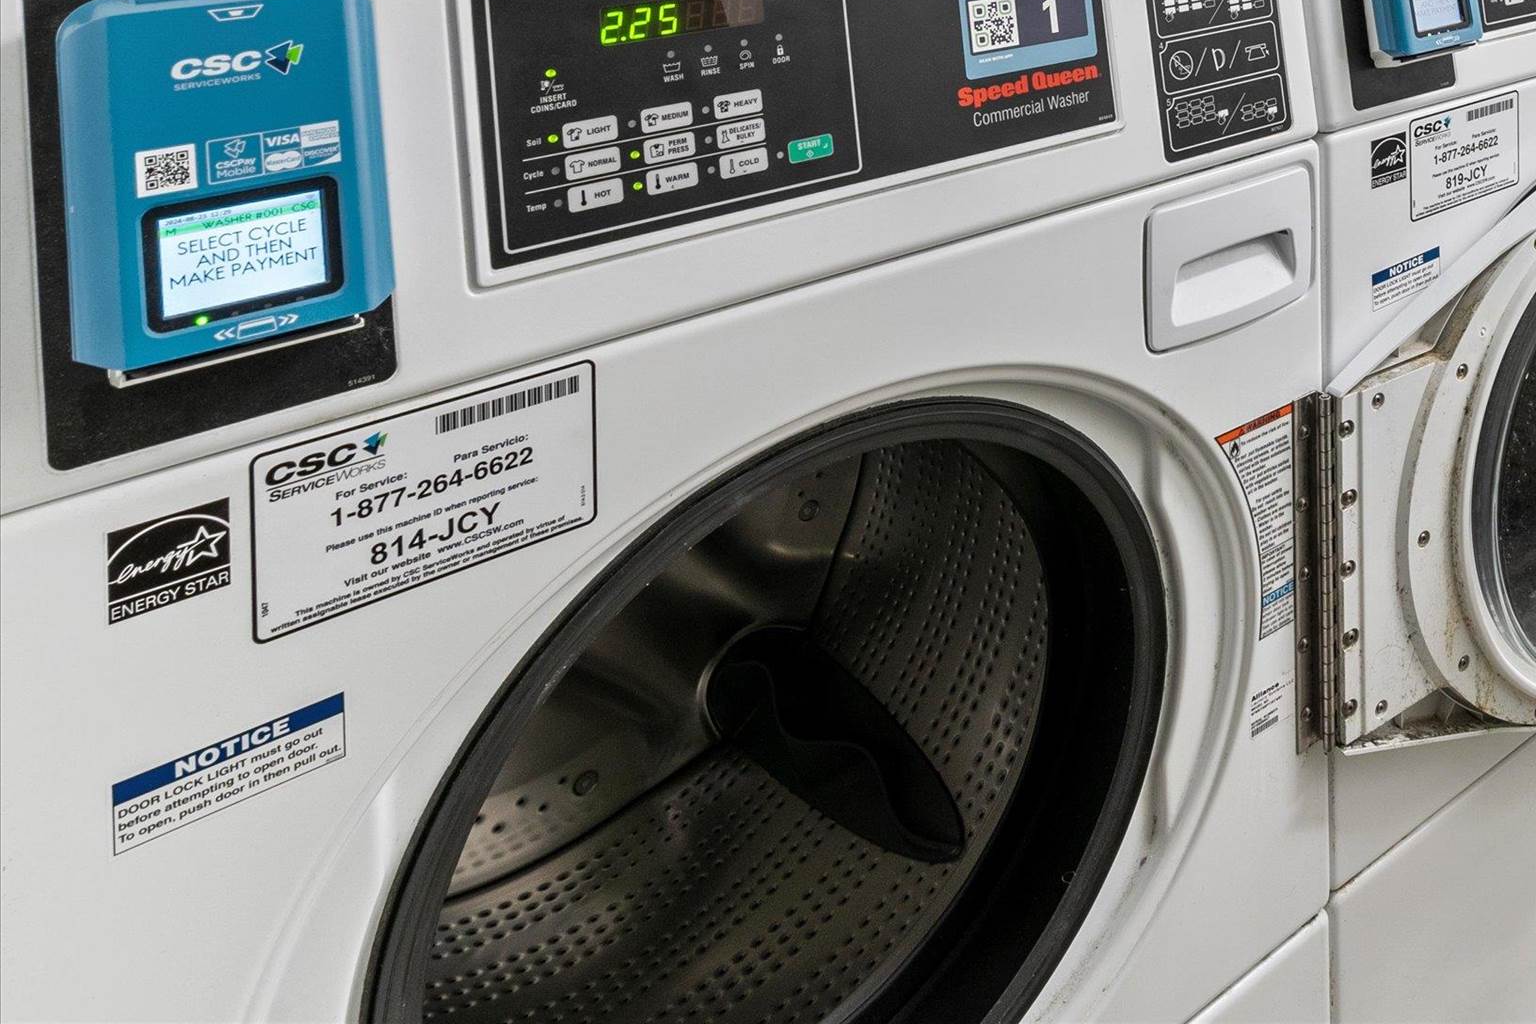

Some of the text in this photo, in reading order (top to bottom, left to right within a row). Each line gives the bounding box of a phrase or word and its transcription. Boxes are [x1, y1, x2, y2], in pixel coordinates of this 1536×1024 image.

[598, 2, 679, 45] 2.25
[170, 50, 262, 80] CSC
[700, 66, 720, 77] RINSE
[739, 60, 754, 70] SPIN
[772, 54, 790, 65] DOOR
[173, 73, 261, 91] SERVICEWORKS
[663, 72, 684, 83] WASH
[957, 64, 1098, 108] Speed Queen
[661, 109, 689, 122] MEDIUM
[733, 97, 757, 108] HEAVY
[973, 90, 1089, 127] Commercial Washer
[525, 136, 541, 147] Soil
[586, 124, 610, 136] LIGHT
[668, 137, 687, 147] PERM
[1413, 119, 1441, 138] CSC
[667, 144, 689, 155] PRESS
[797, 139, 821, 151] START
[1434, 134, 1498, 165] 1-877-264-6622
[522, 168, 544, 181] Cycle
[587, 155, 617, 168] NORMAL
[739, 156, 759, 167] COLD
[665, 171, 689, 183] WARM
[1445, 163, 1487, 190] 819-JCY
[594, 188, 611, 199] HOT
[165, 227, 176, 236] M
[201, 212, 252, 229] WASHER
[255, 206, 283, 219] #001
[291, 200, 315, 212] CSC
[526, 201, 546, 214] Temp
[177, 230, 242, 255] SELECT
[248, 217, 306, 241] CYCLE
[195, 236, 291, 268] AND THEN
[1389, 254, 1423, 277] NOTICE
[169, 246, 318, 290] MAKE PAYMENT
[453, 432, 528, 463] Para Servicio:
[264, 440, 357, 488] CSC
[330, 445, 533, 528] 1-877-264-6622
[335, 470, 407, 500] For Service:
[325, 476, 538, 553] Please use this machine ID when reporting service:
[370, 501, 501, 566] 814-JCY
[344, 517, 523, 587] Visit our website www.CSCSW.com
[111, 569, 228, 621] ENERGY STAR
[1262, 582, 1294, 605] NOTICE
[174, 716, 290, 778] NOTICE
[117, 727, 322, 819] DOOR LOCK LIGHT must go out
[118, 740, 317, 832] before attempting to open door.
[118, 742, 341, 844] To open, push door in then pull out.
